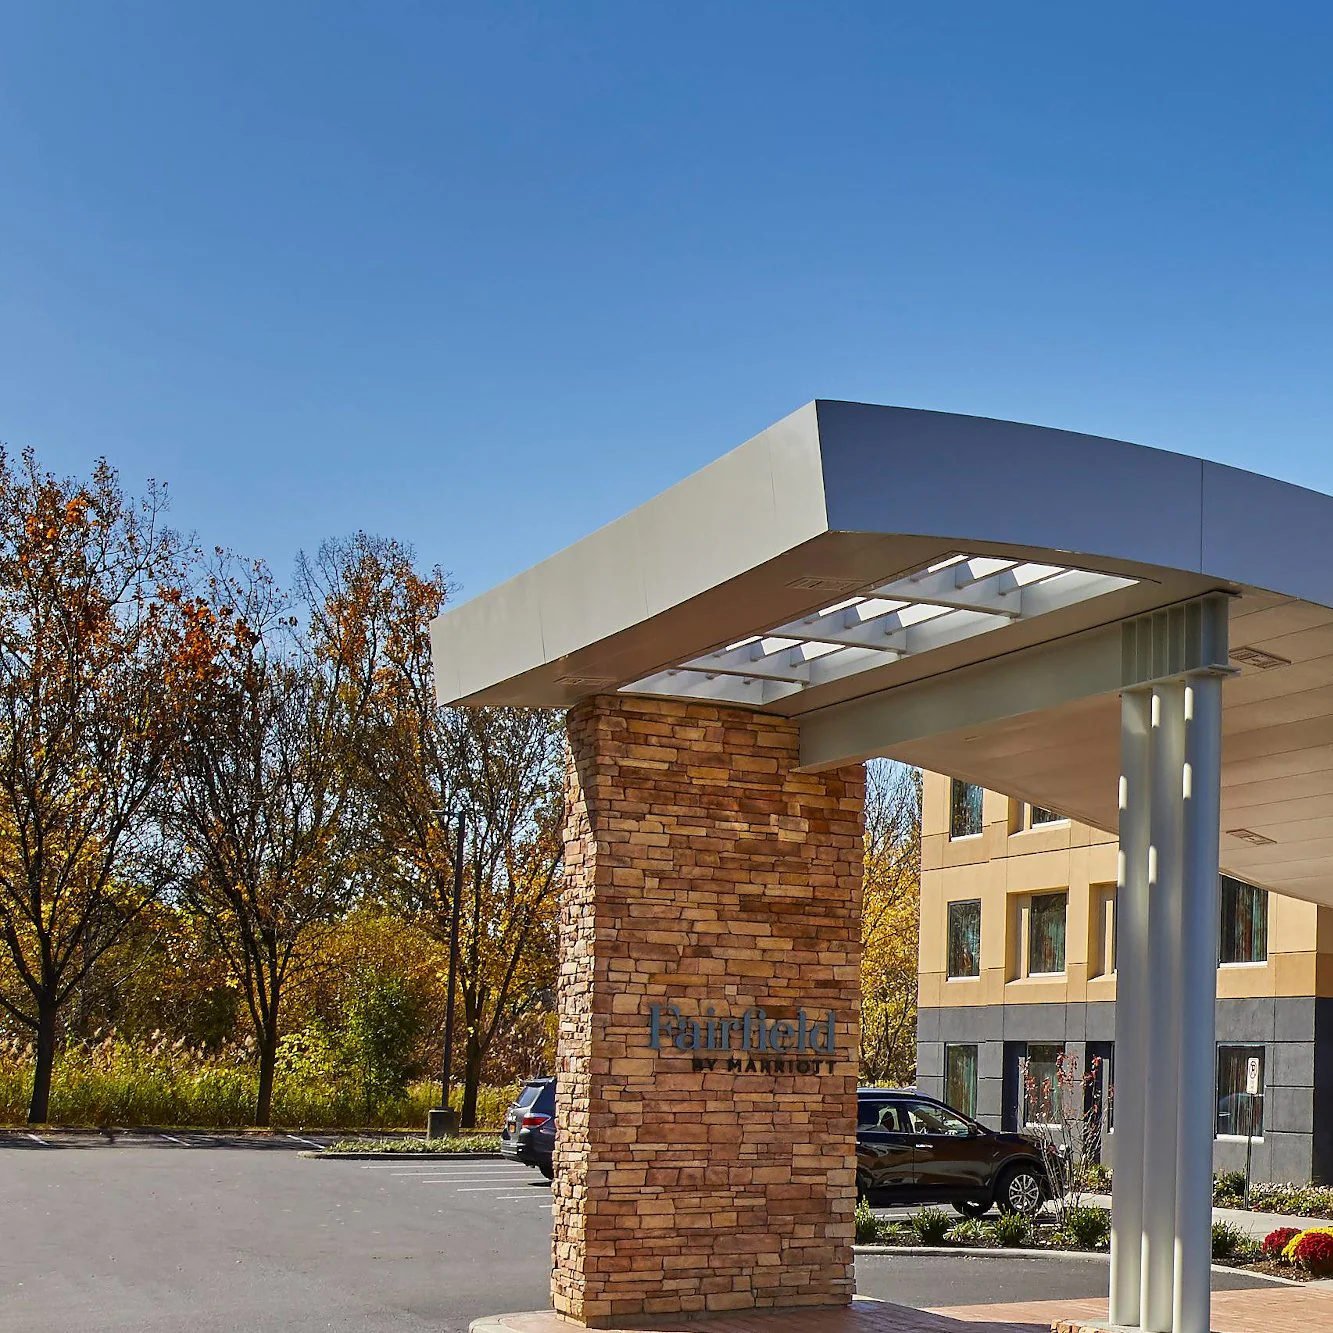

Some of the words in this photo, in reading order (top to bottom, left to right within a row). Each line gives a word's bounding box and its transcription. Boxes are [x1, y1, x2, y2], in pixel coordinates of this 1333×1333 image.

[649, 1004, 836, 1053] Fairfield
[692, 1058, 716, 1073] BY
[727, 1058, 835, 1074] MARRIOTT
